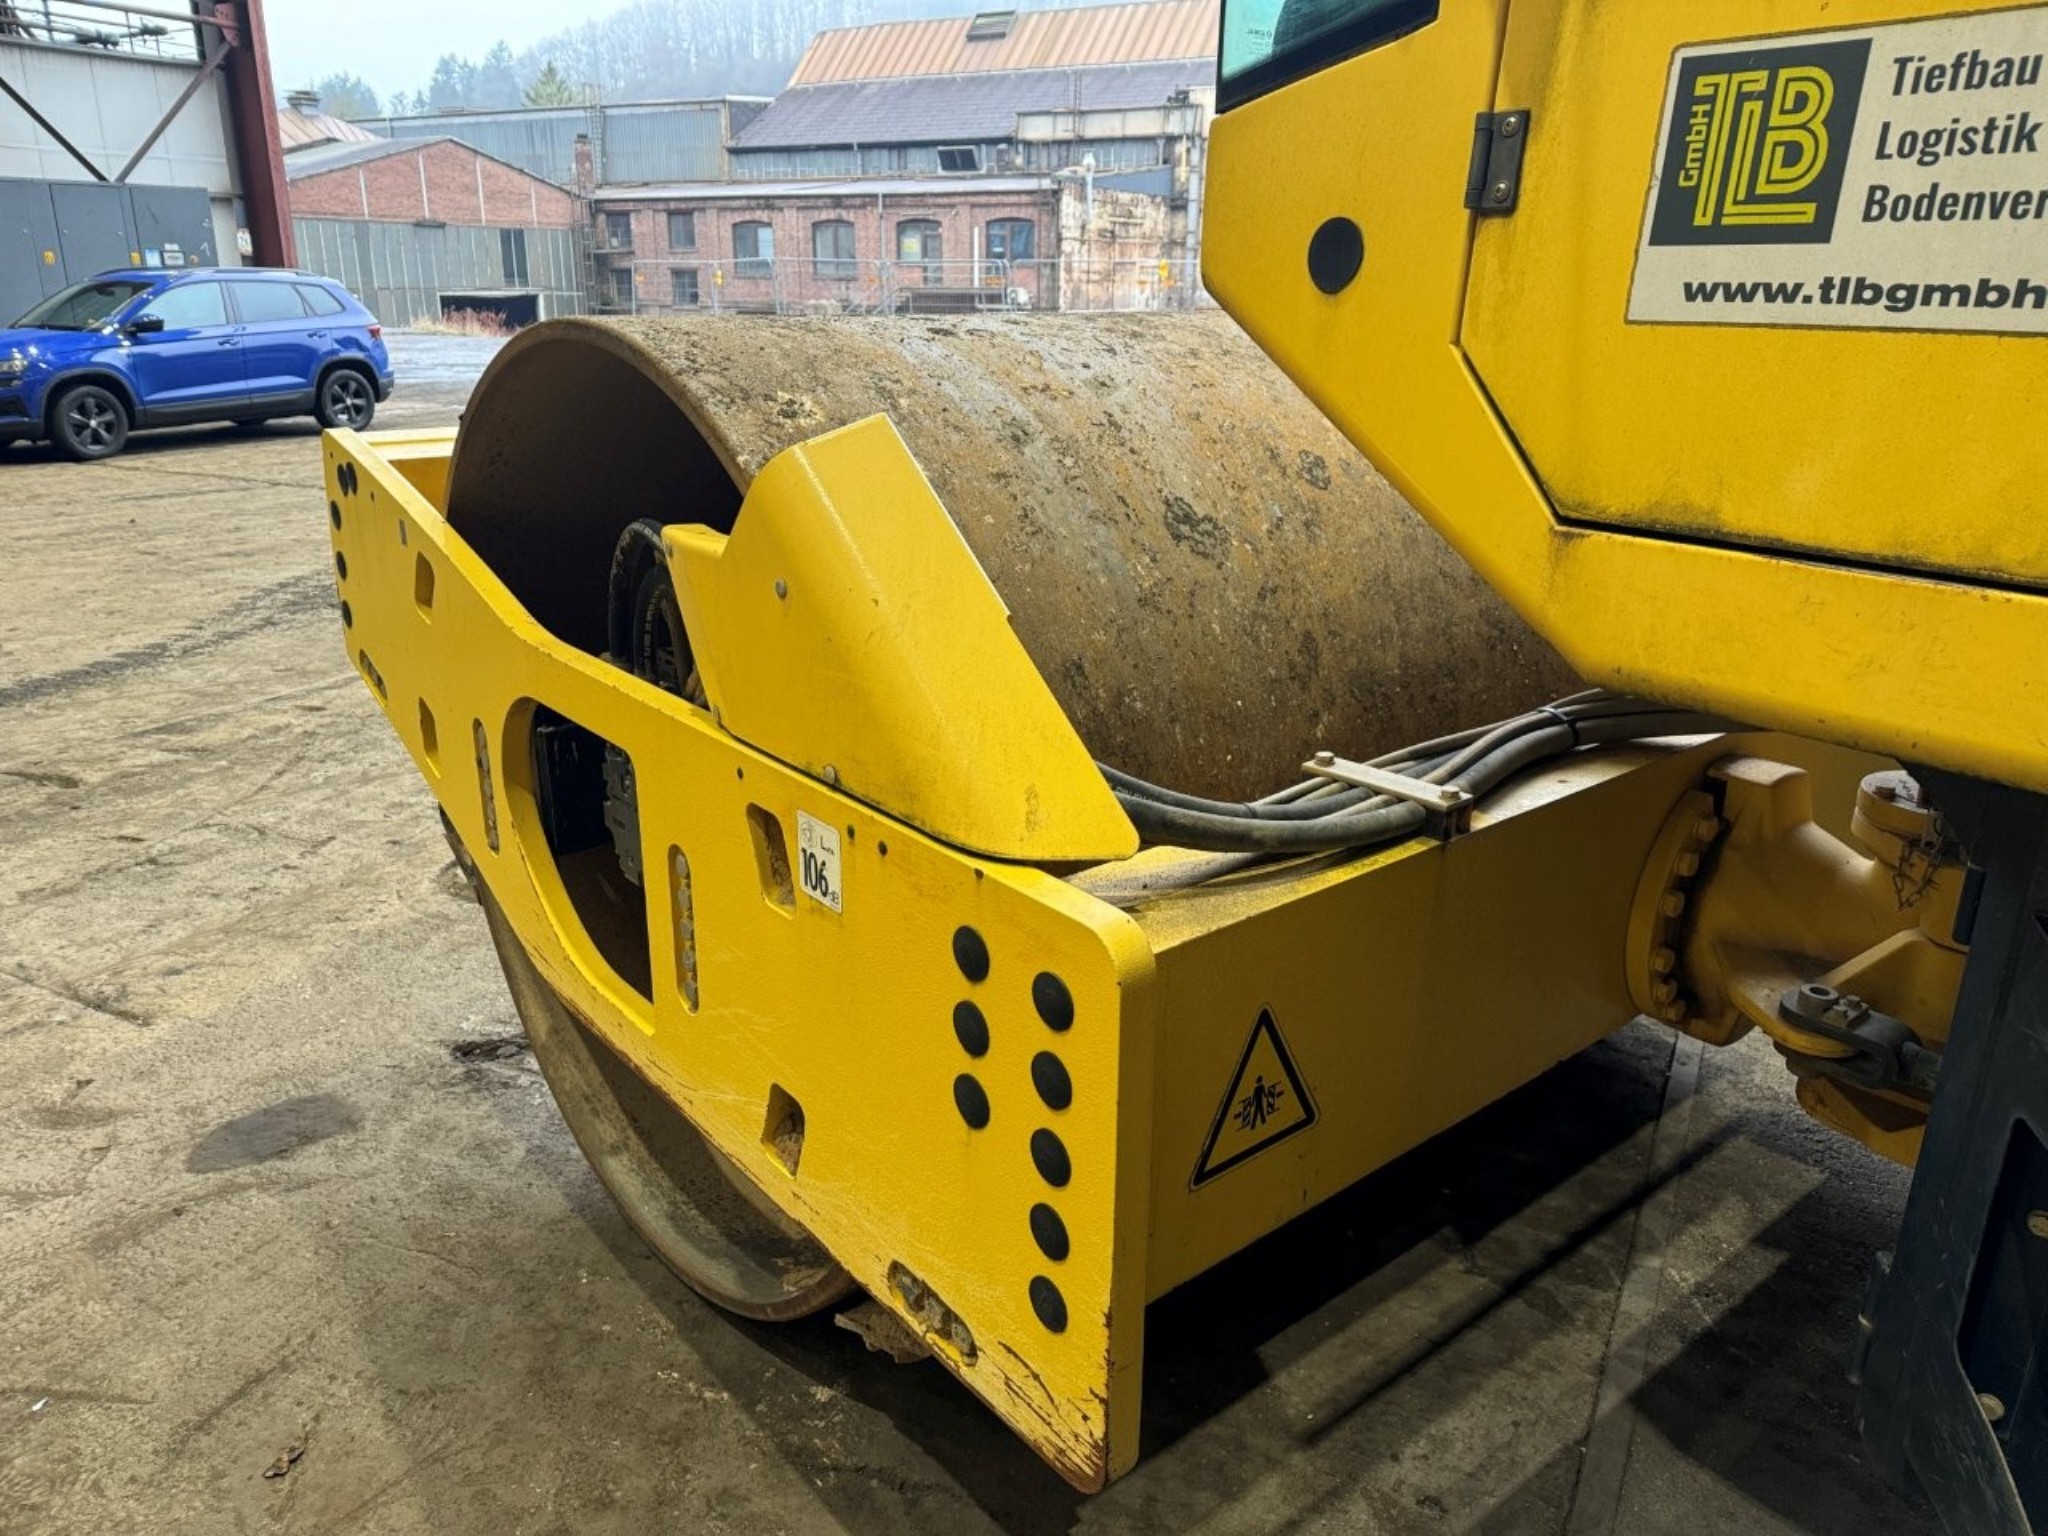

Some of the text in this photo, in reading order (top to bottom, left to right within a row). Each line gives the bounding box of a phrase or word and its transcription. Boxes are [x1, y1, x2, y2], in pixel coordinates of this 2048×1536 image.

[1892, 50, 2043, 96] Tiefbau
[1678, 104, 1711, 186] GmbH
[1693, 66, 1834, 225] TLB
[1875, 112, 2044, 166] Logistik
[1682, 276, 2048, 313] www.tlbgmbh
[801, 847, 829, 898] 106
